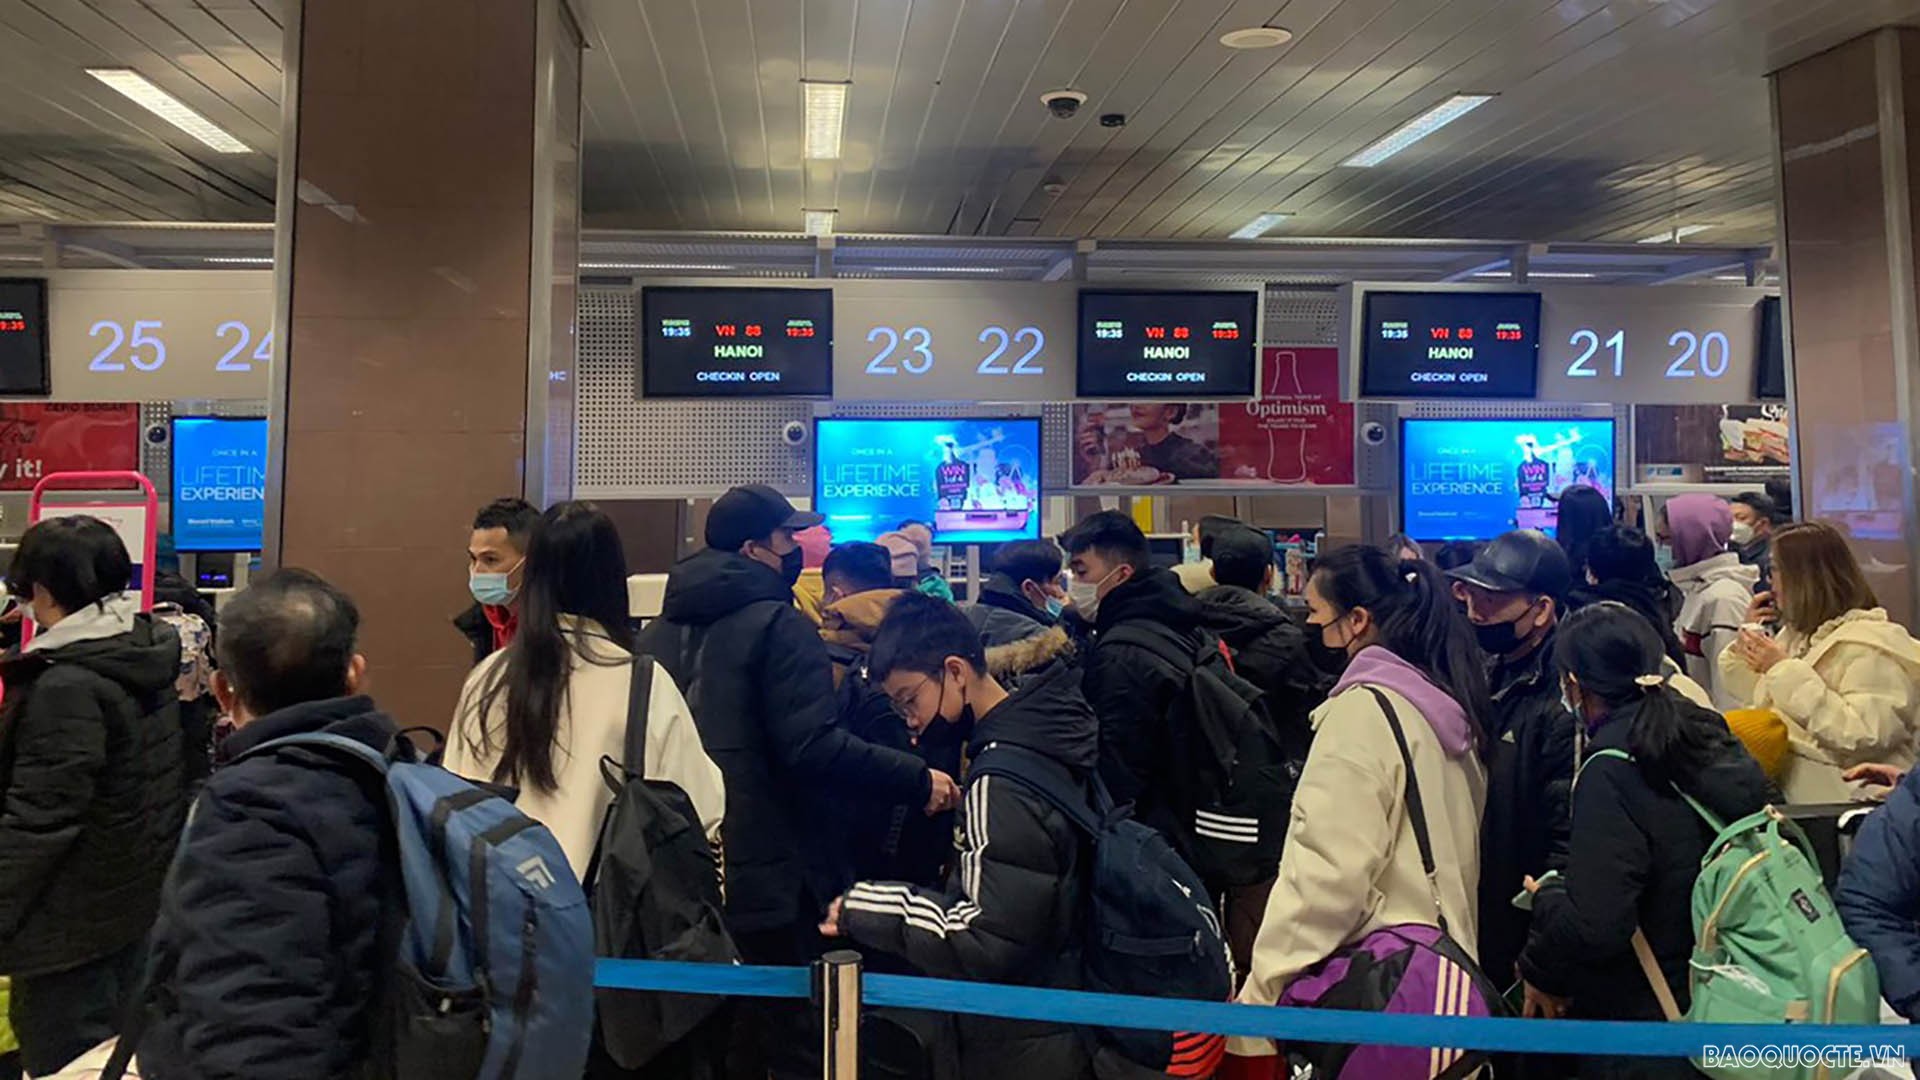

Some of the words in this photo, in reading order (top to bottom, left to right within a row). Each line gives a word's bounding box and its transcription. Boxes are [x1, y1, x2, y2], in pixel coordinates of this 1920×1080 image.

[662, 327, 692, 337] 19:35
[715, 325, 736, 336] VN
[1145, 327, 1166, 338] VN
[1430, 328, 1449, 339] VN
[89, 320, 166, 371] 25
[714, 345, 763, 358] HANOI
[865, 326, 934, 374] 23
[976, 326, 1045, 374] 22
[1144, 346, 1190, 359] HANOI
[1428, 347, 1474, 359] HANOI
[1566, 329, 1624, 377] 21
[1664, 330, 1729, 378] 20
[696, 372, 745, 382] CHECKIN
[750, 372, 780, 382] OPEN
[1126, 372, 1172, 382] CHECKIN
[1176, 372, 1206, 382] OPEN
[1410, 372, 1456, 382] CHECKIN
[1459, 372, 1488, 382] OPEN
[1246, 398, 1327, 418] Optimism
[16, 458, 42, 478] it!
[823, 464, 920, 483] LIFETIME
[1410, 462, 1504, 481] LIFETIME
[823, 484, 920, 498] EXPERIENCE
[1411, 482, 1504, 495] EXPERIENCE
